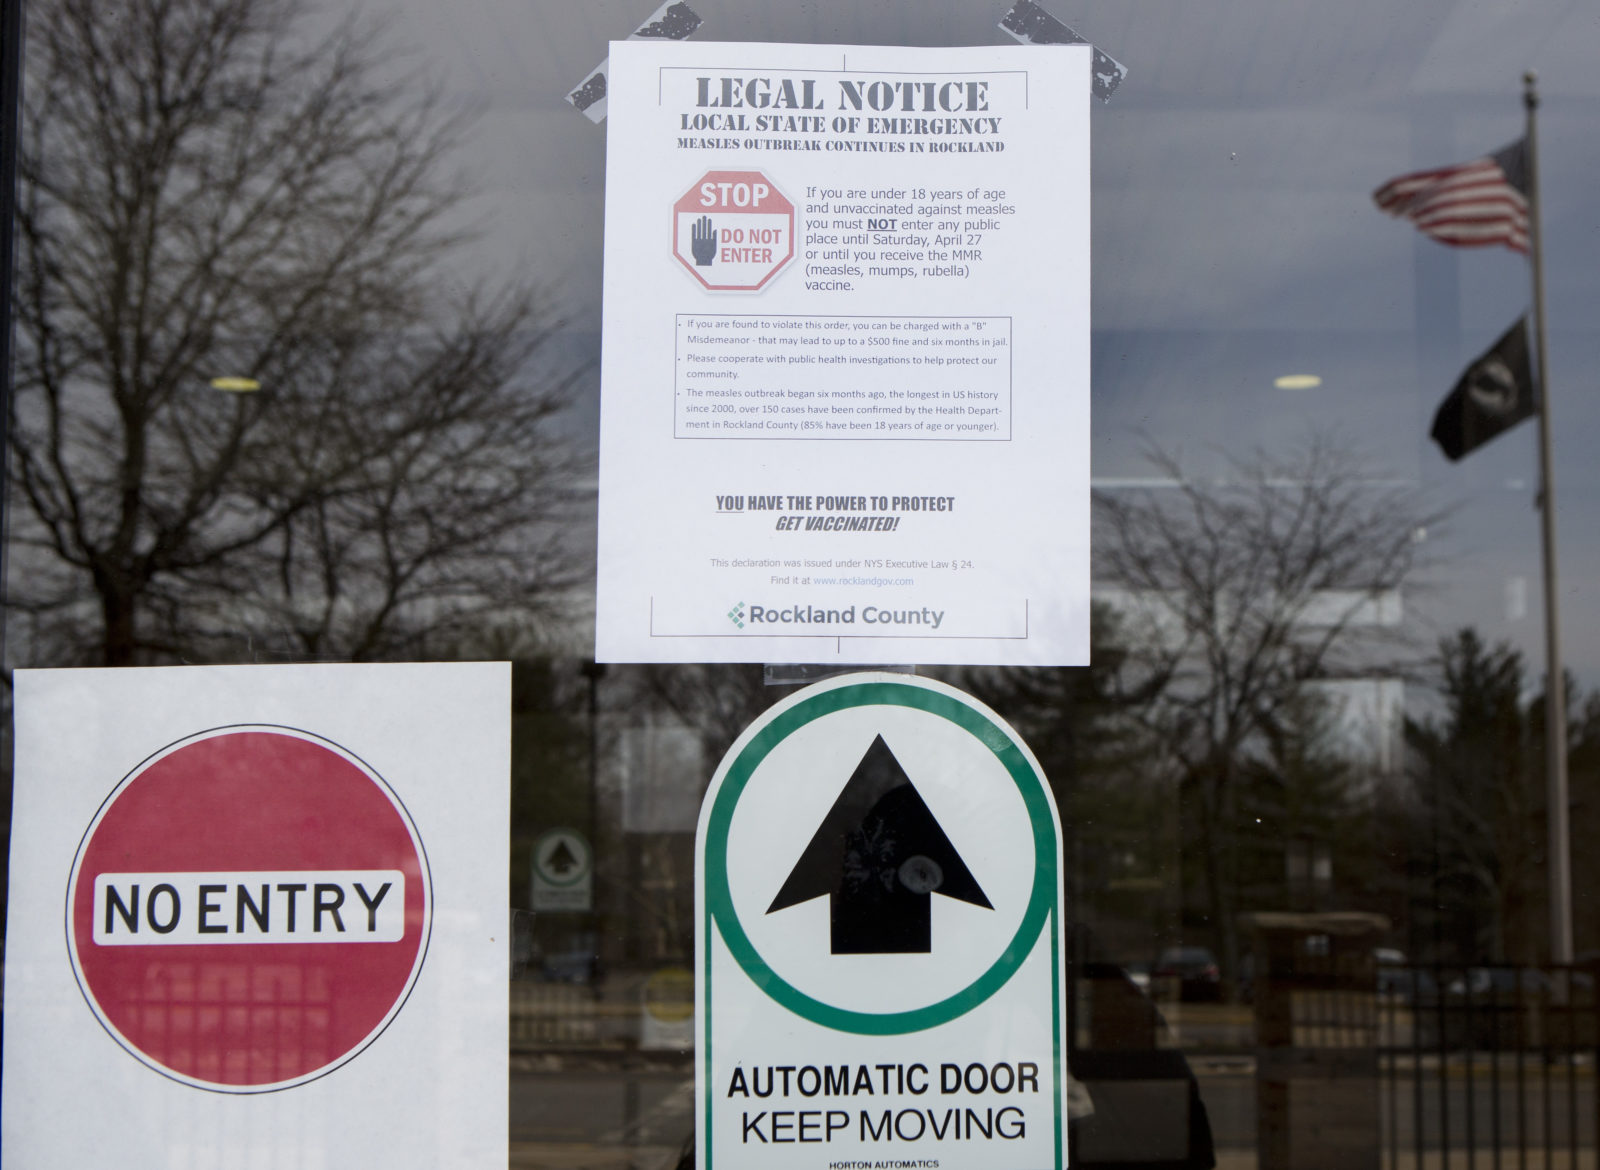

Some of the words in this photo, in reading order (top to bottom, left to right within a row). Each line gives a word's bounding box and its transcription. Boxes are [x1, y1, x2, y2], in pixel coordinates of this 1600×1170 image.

[695, 77, 824, 110] LEGAL
[837, 80, 988, 112] NOTICE
[680, 113, 750, 131] LOCAL
[755, 114, 825, 133] STATE
[831, 116, 860, 133] OF
[866, 117, 1002, 135] EMERGENCY
[677, 137, 740, 149] MEASLES
[743, 138, 821, 151] OUTBREAK
[825, 140, 905, 152] CONTINUES
[909, 142, 925, 153] IN
[928, 141, 1004, 153] ROCKLAND
[699, 182, 771, 206] STOP
[806, 186, 817, 198] If
[819, 189, 842, 200] you
[846, 189, 867, 199] are
[870, 187, 907, 199] under
[911, 188, 926, 200] 18
[929, 190, 963, 201] years
[966, 187, 980, 199] of
[983, 190, 1006, 202] age
[805, 201, 829, 213] and
[833, 202, 913, 214] unvaccinated
[917, 203, 962, 216] against
[966, 202, 1016, 215] measles
[805, 219, 828, 231] you
[832, 218, 863, 229] must
[866, 218, 898, 232] NOT
[901, 219, 934, 230] enter
[937, 221, 960, 232] any
[964, 218, 1000, 232] public
[720, 228, 744, 244] DO
[749, 228, 782, 244] NOT
[805, 232, 838, 246] place
[842, 233, 868, 245] until
[872, 233, 930, 247] Saturday,
[934, 233, 962, 248] April
[966, 233, 982, 245] 27
[720, 247, 772, 263] ENTER
[805, 250, 819, 260] or
[822, 248, 849, 260] until
[853, 250, 876, 263] you
[880, 249, 924, 261] receive
[927, 249, 948, 261] the
[952, 249, 982, 261] MMR
[805, 263, 864, 278] (measles,
[868, 266, 917, 278] mumps,
[922, 264, 969, 279] rubella)
[804, 279, 854, 291] vaccine.
[687, 318, 694, 327] If
[695, 321, 712, 329] you
[731, 319, 758, 328] found
[760, 320, 771, 328] to
[772, 320, 803, 329] violate
[804, 320, 822, 329] this
[823, 320, 850, 331] order,
[852, 322, 869, 331] you
[889, 321, 901, 330] be
[903, 321, 939, 332] charged
[941, 321, 962, 330] with
[687, 335, 750, 344] Misdemeanor
[758, 335, 776, 344] that
[778, 337, 798, 346] may
[800, 336, 820, 345] lead
[821, 336, 832, 345] to
[833, 338, 846, 347] up
[847, 337, 858, 345] to
[867, 336, 890, 346] $500
[892, 336, 909, 346] fine
[911, 336, 929, 346] and
[931, 337, 943, 346] six
[945, 337, 980, 346] months
[981, 337, 990, 346] in
[992, 337, 1008, 348] jail.
[687, 353, 716, 363] Please
[718, 355, 764, 364] cooperate
[765, 354, 786, 363] with
[788, 354, 815, 365] public
[818, 354, 846, 364] health
[849, 355, 910, 366] investigations
[912, 356, 922, 364] to
[924, 355, 944, 366] help
[946, 356, 979, 366] protect
[981, 357, 997, 365] our
[686, 369, 739, 380] community.
[685, 388, 703, 397] The
[705, 388, 742, 397] measles
[744, 388, 785, 398] outbreak
[787, 388, 815, 399] began
[816, 389, 829, 398] six
[831, 389, 866, 398] months
[867, 391, 886, 400] ago,
[889, 389, 904, 399] the
[906, 389, 939, 400] longest
[941, 390, 950, 399] in
[952, 390, 965, 399] US
[967, 390, 998, 400] history
[685, 404, 709, 413] since
[711, 404, 736, 414] 2000,
[762, 404, 779, 413] 150
[780, 406, 805, 414] cases
[807, 404, 829, 414] have
[831, 404, 854, 414] been
[856, 404, 902, 414] confirmed
[904, 405, 916, 415] by
[917, 405, 933, 414] the
[935, 405, 965, 415] Health
[967, 406, 1002, 416] Depart-
[685, 420, 710, 428] ment
[712, 420, 720, 428] in
[723, 419, 763, 429] Rockland
[765, 420, 798, 431] County
[800, 420, 823, 430] (85%
[825, 420, 847, 429] have
[849, 420, 872, 430] been
[874, 420, 886, 430] 18
[887, 423, 913, 431] years
[913, 420, 924, 430] of
[925, 423, 942, 431] age
[955, 421, 999, 432] younger).
[715, 495, 744, 513] YOU
[747, 495, 783, 510] HAVE
[786, 495, 812, 510] THE
[815, 495, 867, 511] POWER
[869, 495, 888, 511] TO
[891, 495, 955, 512] PROTECT
[775, 515, 805, 531] GET
[804, 516, 900, 531] VACCINATED!
[709, 558, 729, 567] This
[731, 558, 780, 567] declaration
[783, 559, 801, 567] was
[804, 558, 832, 568] issued
[835, 559, 862, 568] under
[864, 559, 883, 568] NYS
[885, 559, 928, 568] Executive
[930, 559, 949, 569] Law
[960, 559, 975, 569] 24.
[770, 575, 790, 584] Find
[792, 575, 799, 584] it
[800, 576, 811, 585] at
[812, 576, 914, 588] www.rocklandgov.com
[749, 604, 855, 624] Rockland
[861, 606, 944, 629] County
[104, 883, 181, 934] NO
[198, 882, 392, 934] ENTRY
[727, 1064, 929, 1098] AUTOMATIC
[940, 1061, 1038, 1095] DOOR
[742, 1110, 850, 1143] KEEP
[859, 1106, 1025, 1142] MOVING
[829, 1161, 872, 1170] HORTON
[874, 1159, 939, 1169] AUTOMATICS
